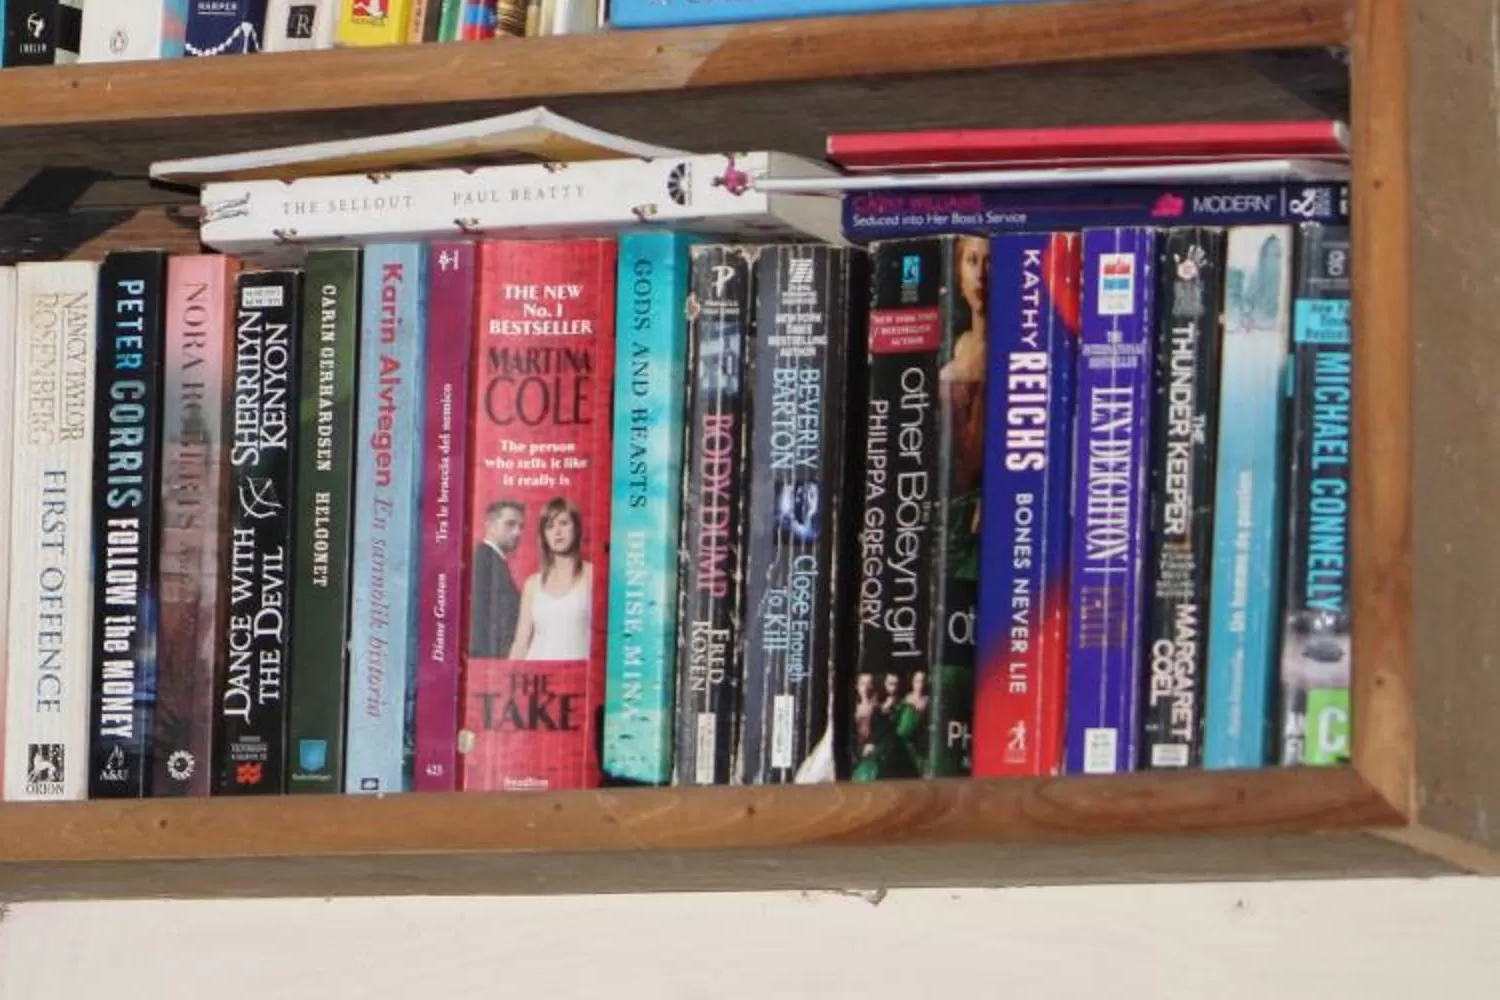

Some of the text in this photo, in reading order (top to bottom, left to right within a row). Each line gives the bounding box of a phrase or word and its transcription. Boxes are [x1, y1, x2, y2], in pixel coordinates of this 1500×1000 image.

[280, 184, 587, 216] THE SELLOUT PAUL BEATTY
[488, 319, 593, 336] BESTSELLER
[502, 284, 584, 299] THE NEW
[230, 310, 262, 467] SHERRILYN
[259, 322, 289, 450] KENYON
[484, 375, 593, 427] COLE
[486, 348, 593, 375] MARTINA
[769, 368, 796, 470] BARTON
[797, 369, 821, 470] BEVERLY
[101, 280, 145, 738] PETER CORRIS FOLLOW the MONEY
[859, 400, 889, 629] PHILIPPA GREGORY
[1006, 250, 1048, 694] KATHY REICHS BONES NEVER LIE
[1305, 351, 1350, 612] MICHAEL CONNELLY
[36, 470, 68, 714] FIRST OFFENCE
[231, 527, 255, 604] WITH
[223, 614, 252, 724] DANCE
[254, 545, 284, 705] THE DEVIL
[1150, 639, 1174, 706] COEL
[1170, 604, 1197, 741] MARGARET
[475, 693, 581, 731] TAKE
[509, 674, 552, 695] THE
